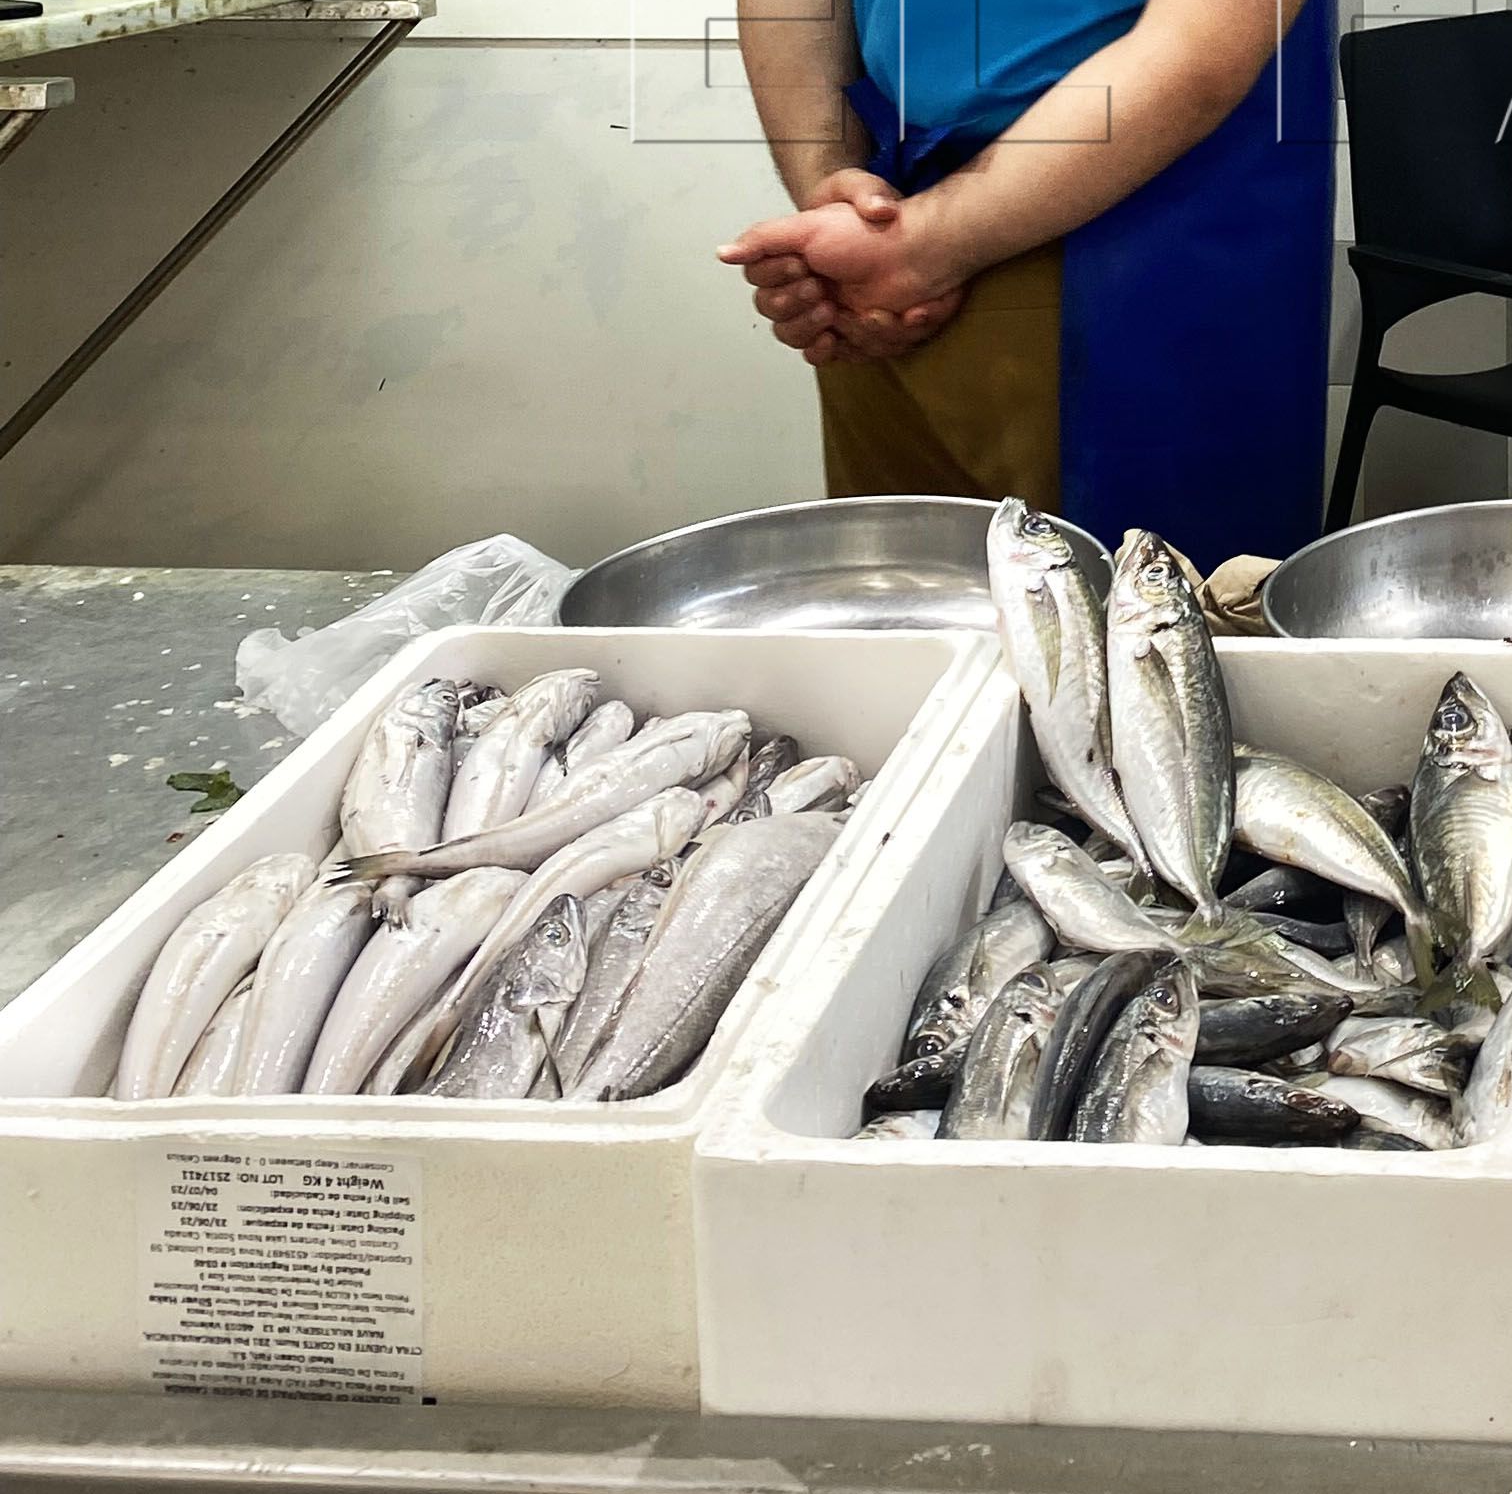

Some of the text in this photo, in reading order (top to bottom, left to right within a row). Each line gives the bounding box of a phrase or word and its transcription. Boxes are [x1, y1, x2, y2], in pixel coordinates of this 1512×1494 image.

[182, 1170, 230, 1182] 2517411
[262, 1174, 283, 1185] LOT
[302, 1175, 321, 1187] KG
[335, 1174, 384, 1190] Weight
[367, 1224, 405, 1235] Packing
